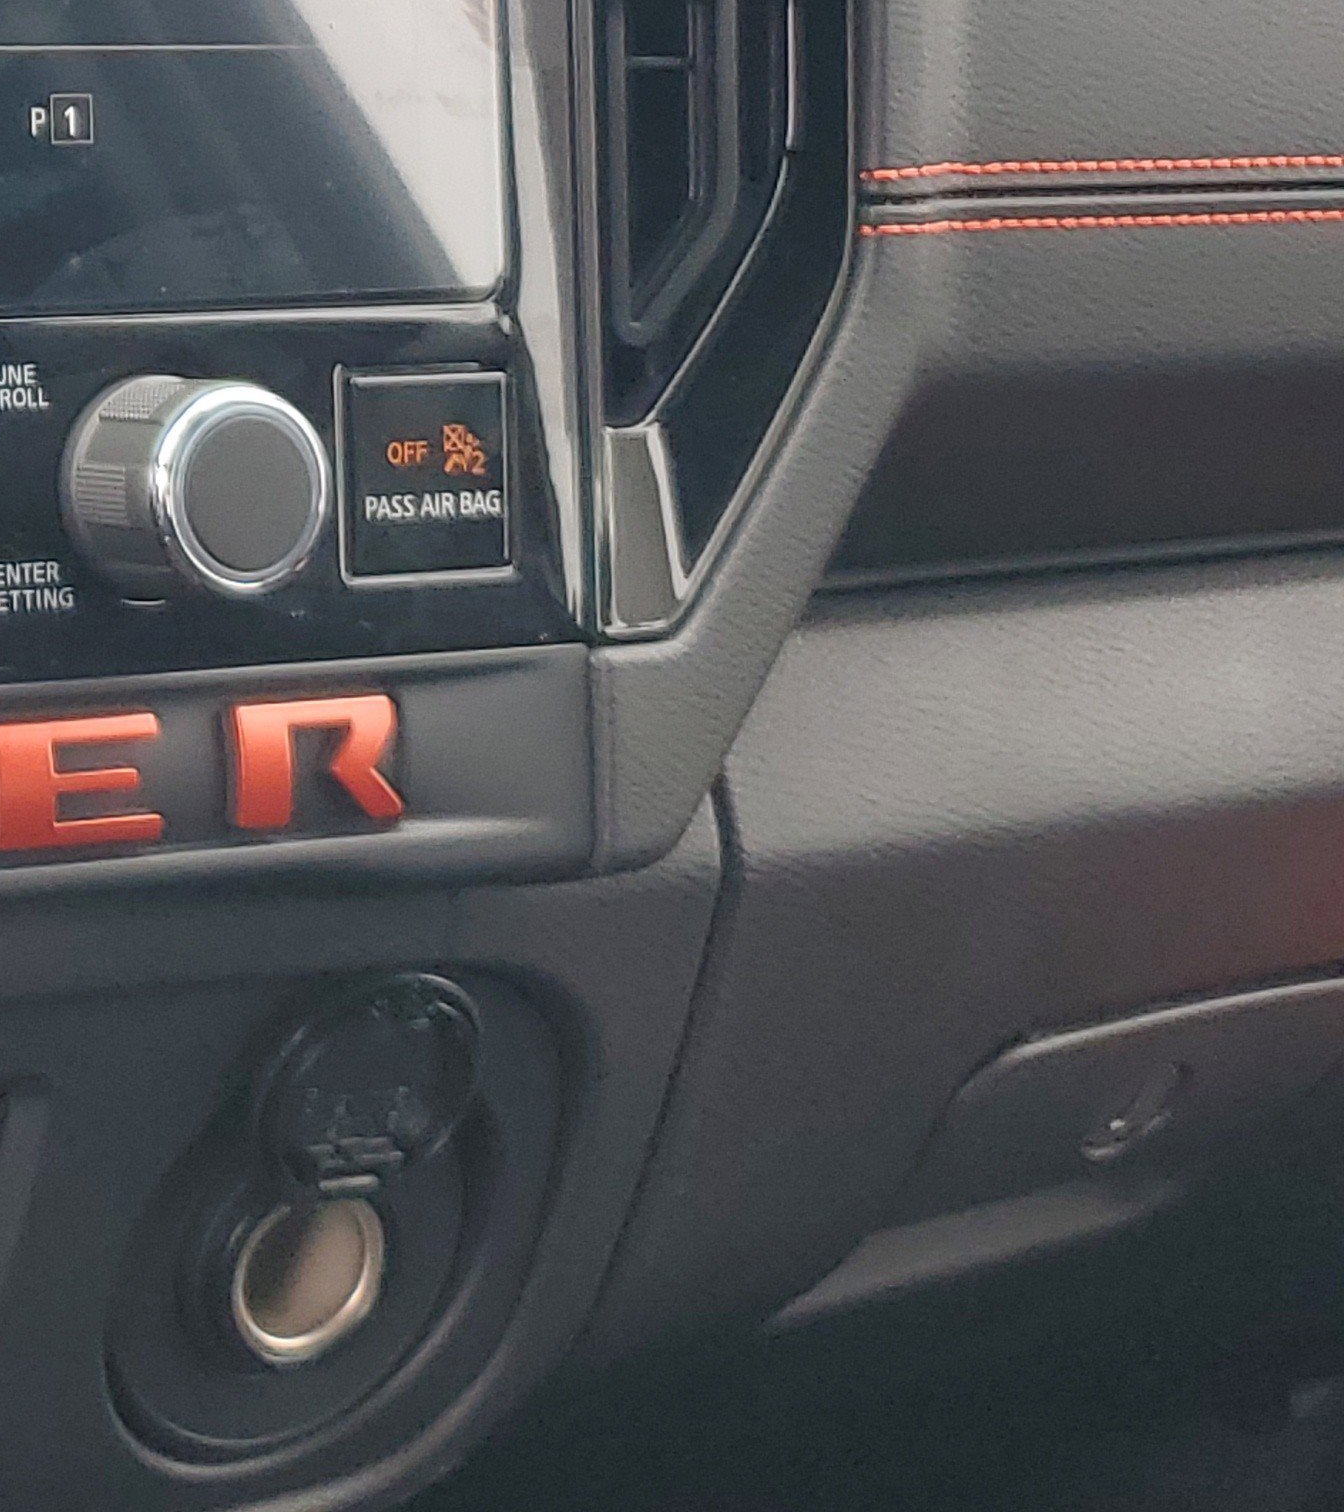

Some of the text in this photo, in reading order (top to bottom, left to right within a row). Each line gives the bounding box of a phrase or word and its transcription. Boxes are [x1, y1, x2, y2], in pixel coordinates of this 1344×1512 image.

[386, 439, 429, 466] OFF
[364, 488, 502, 521] PASS AIR BAG
